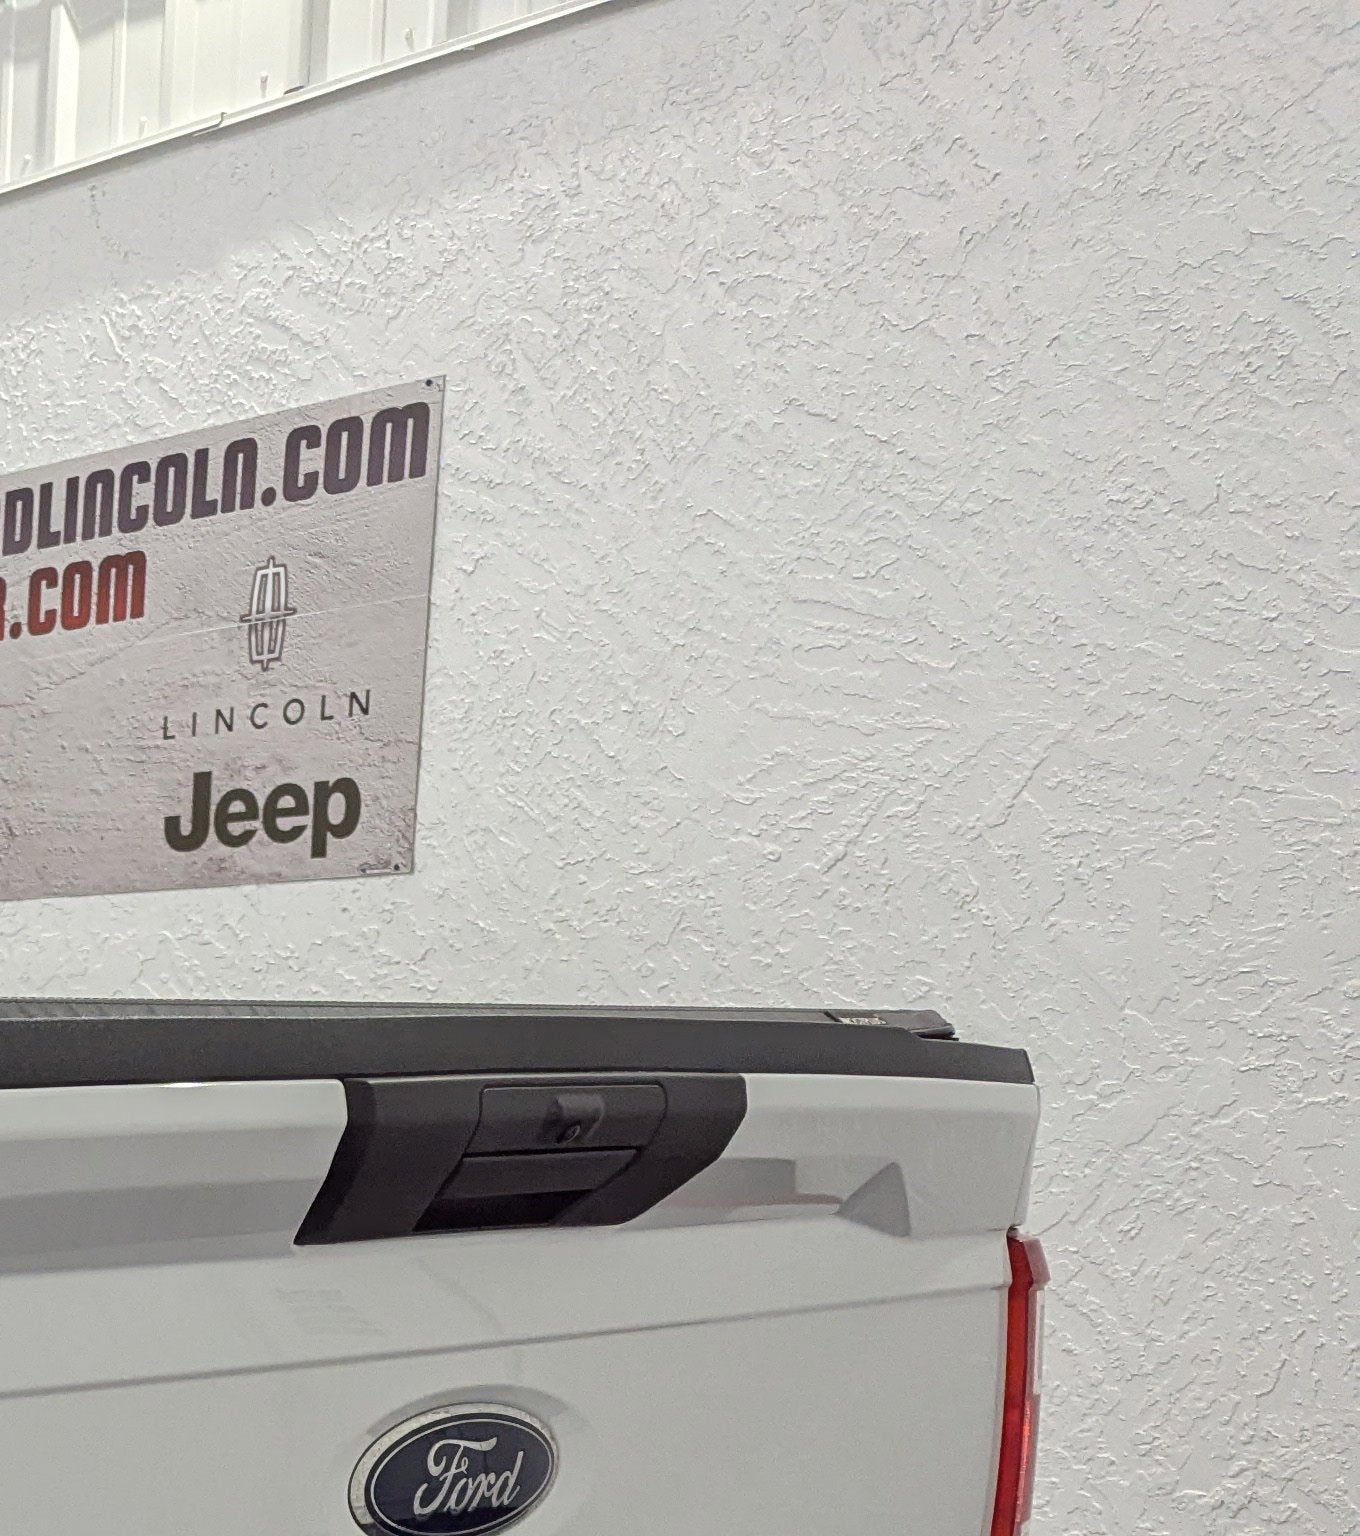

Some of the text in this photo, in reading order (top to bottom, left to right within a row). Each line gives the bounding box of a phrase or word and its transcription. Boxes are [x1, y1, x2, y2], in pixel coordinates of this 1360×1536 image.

[162, 689, 372, 740] LINCOLN
[164, 771, 362, 859] Jeep
[412, 1436, 524, 1520] Ford
